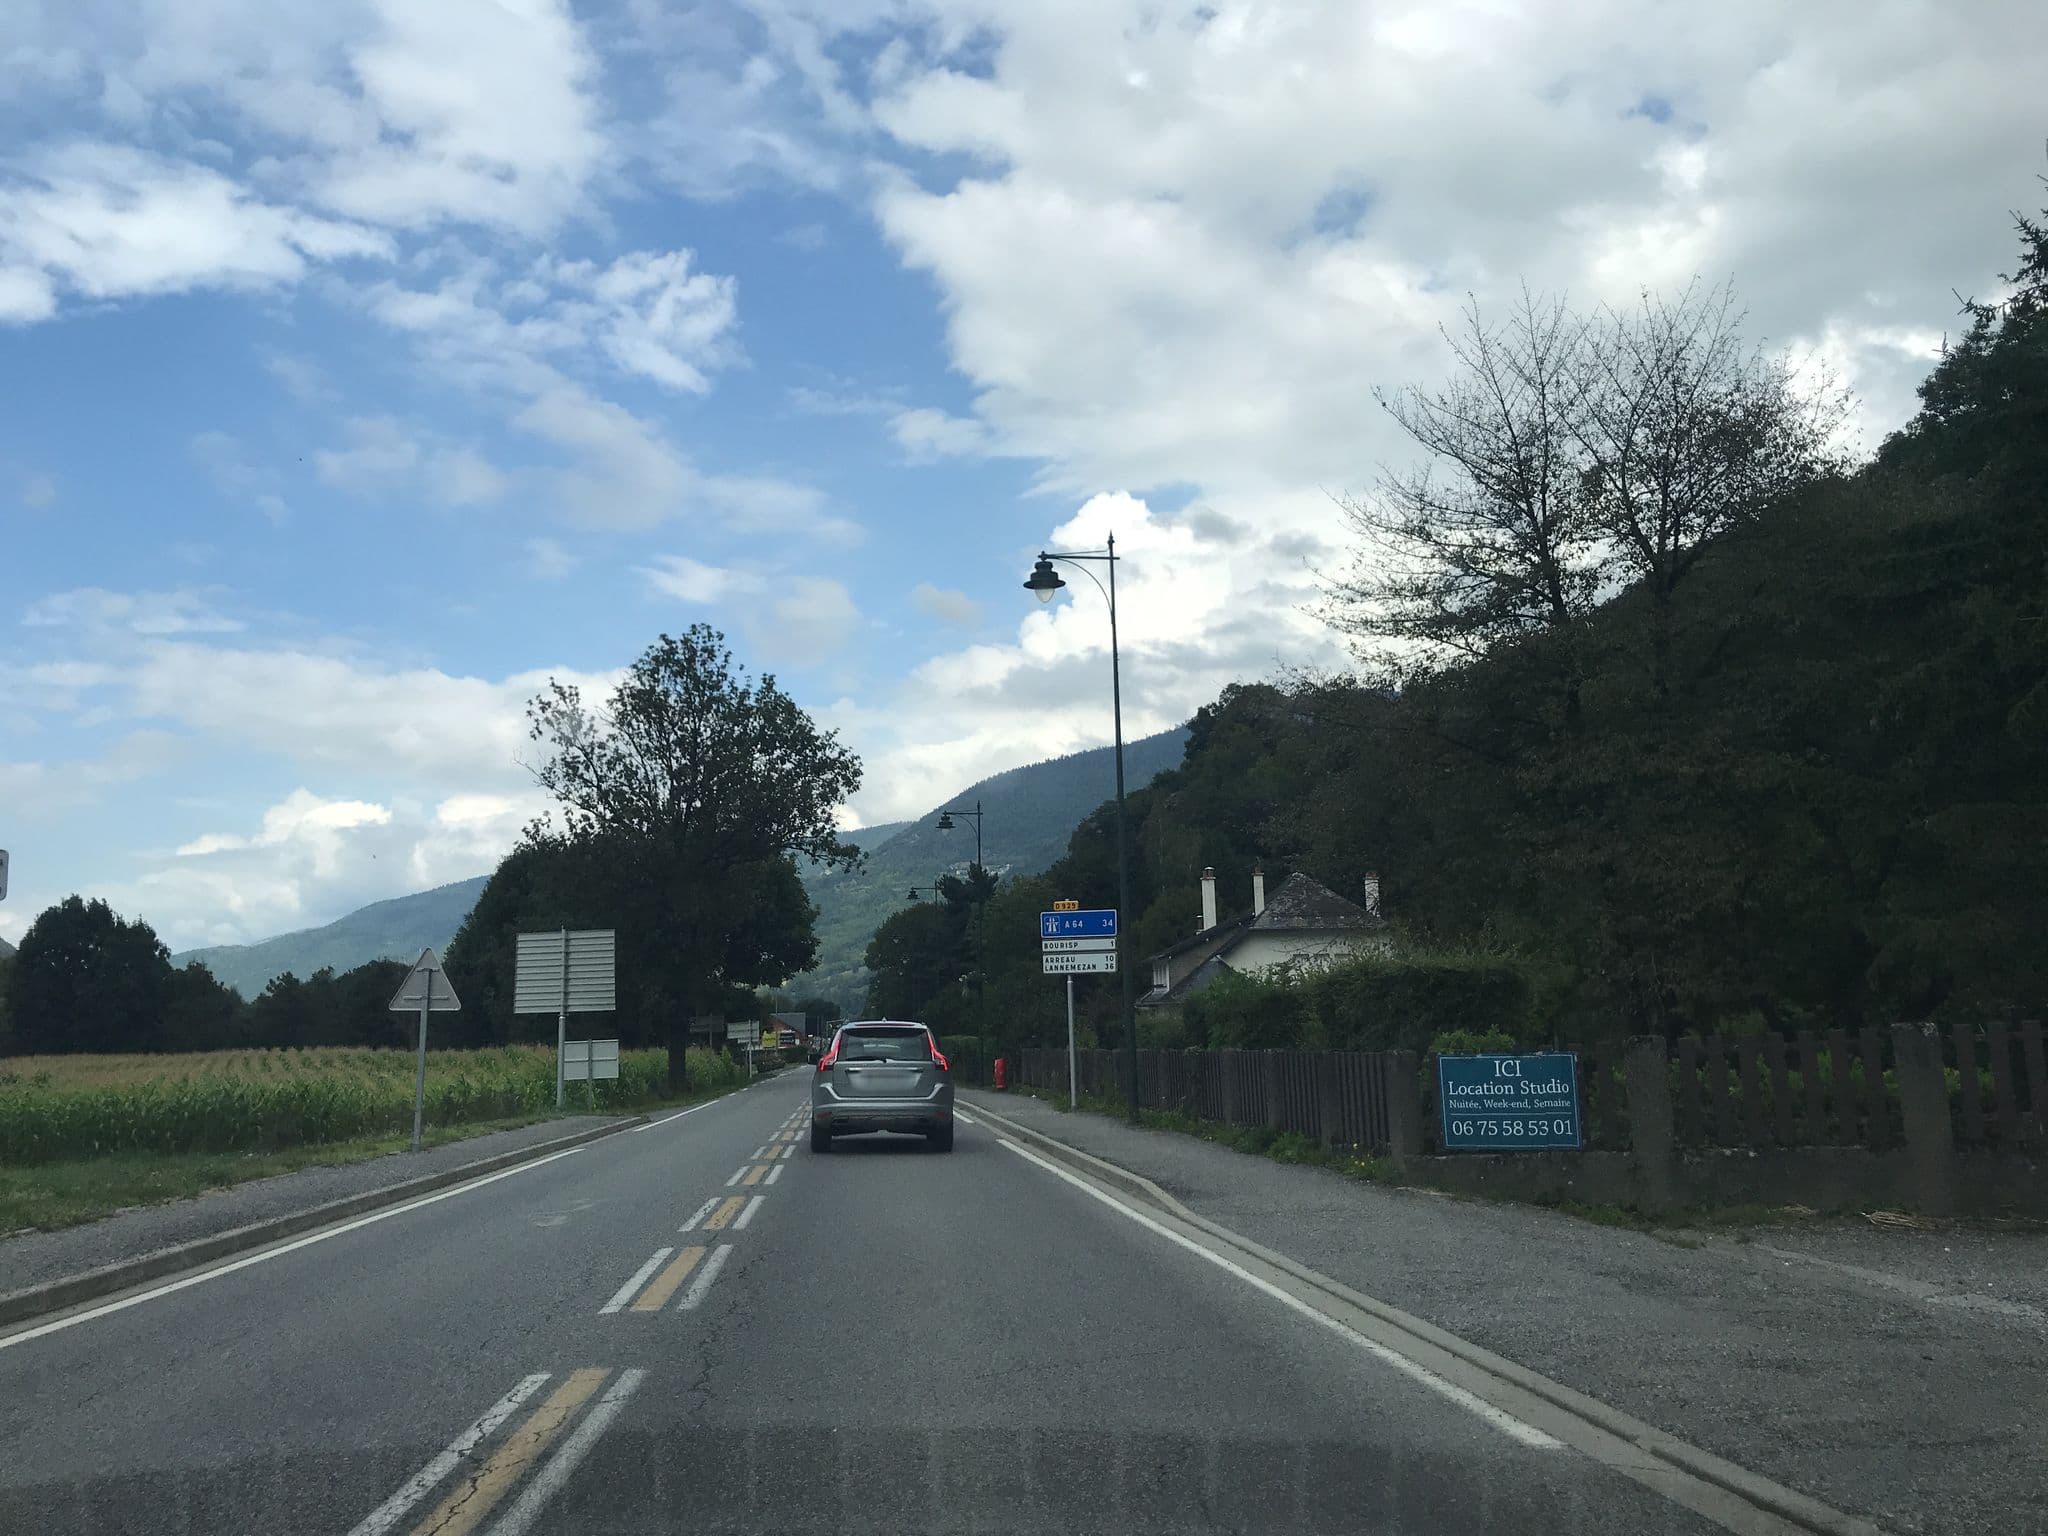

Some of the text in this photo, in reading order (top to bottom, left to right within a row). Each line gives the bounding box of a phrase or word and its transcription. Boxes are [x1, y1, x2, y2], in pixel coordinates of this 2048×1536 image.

[1102, 919, 1113, 927] 34
[1494, 1060, 1522, 1077] ICI
[1448, 1079, 1569, 1095] Location Studio
[1449, 1099, 1571, 1109] Nuitée, Week-end, Semaine
